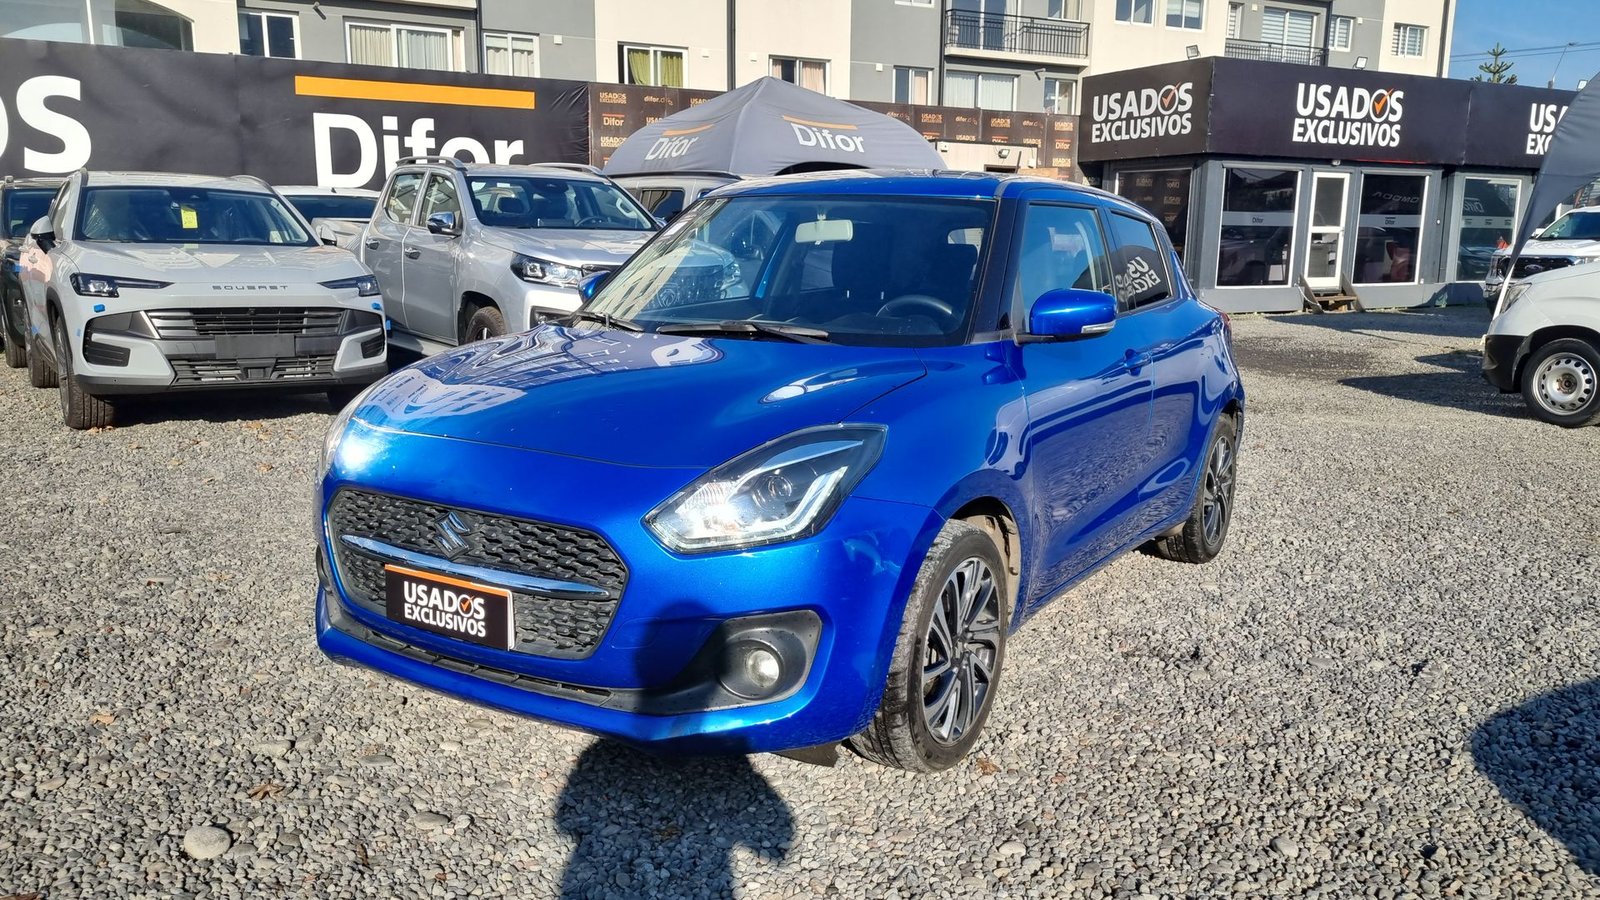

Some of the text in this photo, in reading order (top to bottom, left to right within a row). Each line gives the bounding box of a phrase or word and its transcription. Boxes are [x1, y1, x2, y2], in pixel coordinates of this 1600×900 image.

[1092, 82, 1193, 122] USADOS
[1296, 83, 1404, 122] USADOS
[0, 75, 91, 173] S
[603, 117, 625, 126] Difor
[1091, 113, 1192, 143] EXCLUSIVOS
[1292, 118, 1401, 147] EXCLUSIVOS
[645, 136, 699, 161] Difor
[790, 122, 865, 153] Difor
[1055, 141, 1071, 150] Difor
[403, 580, 485, 620] USADOS
[404, 603, 486, 638] EXCLUSIVOS
